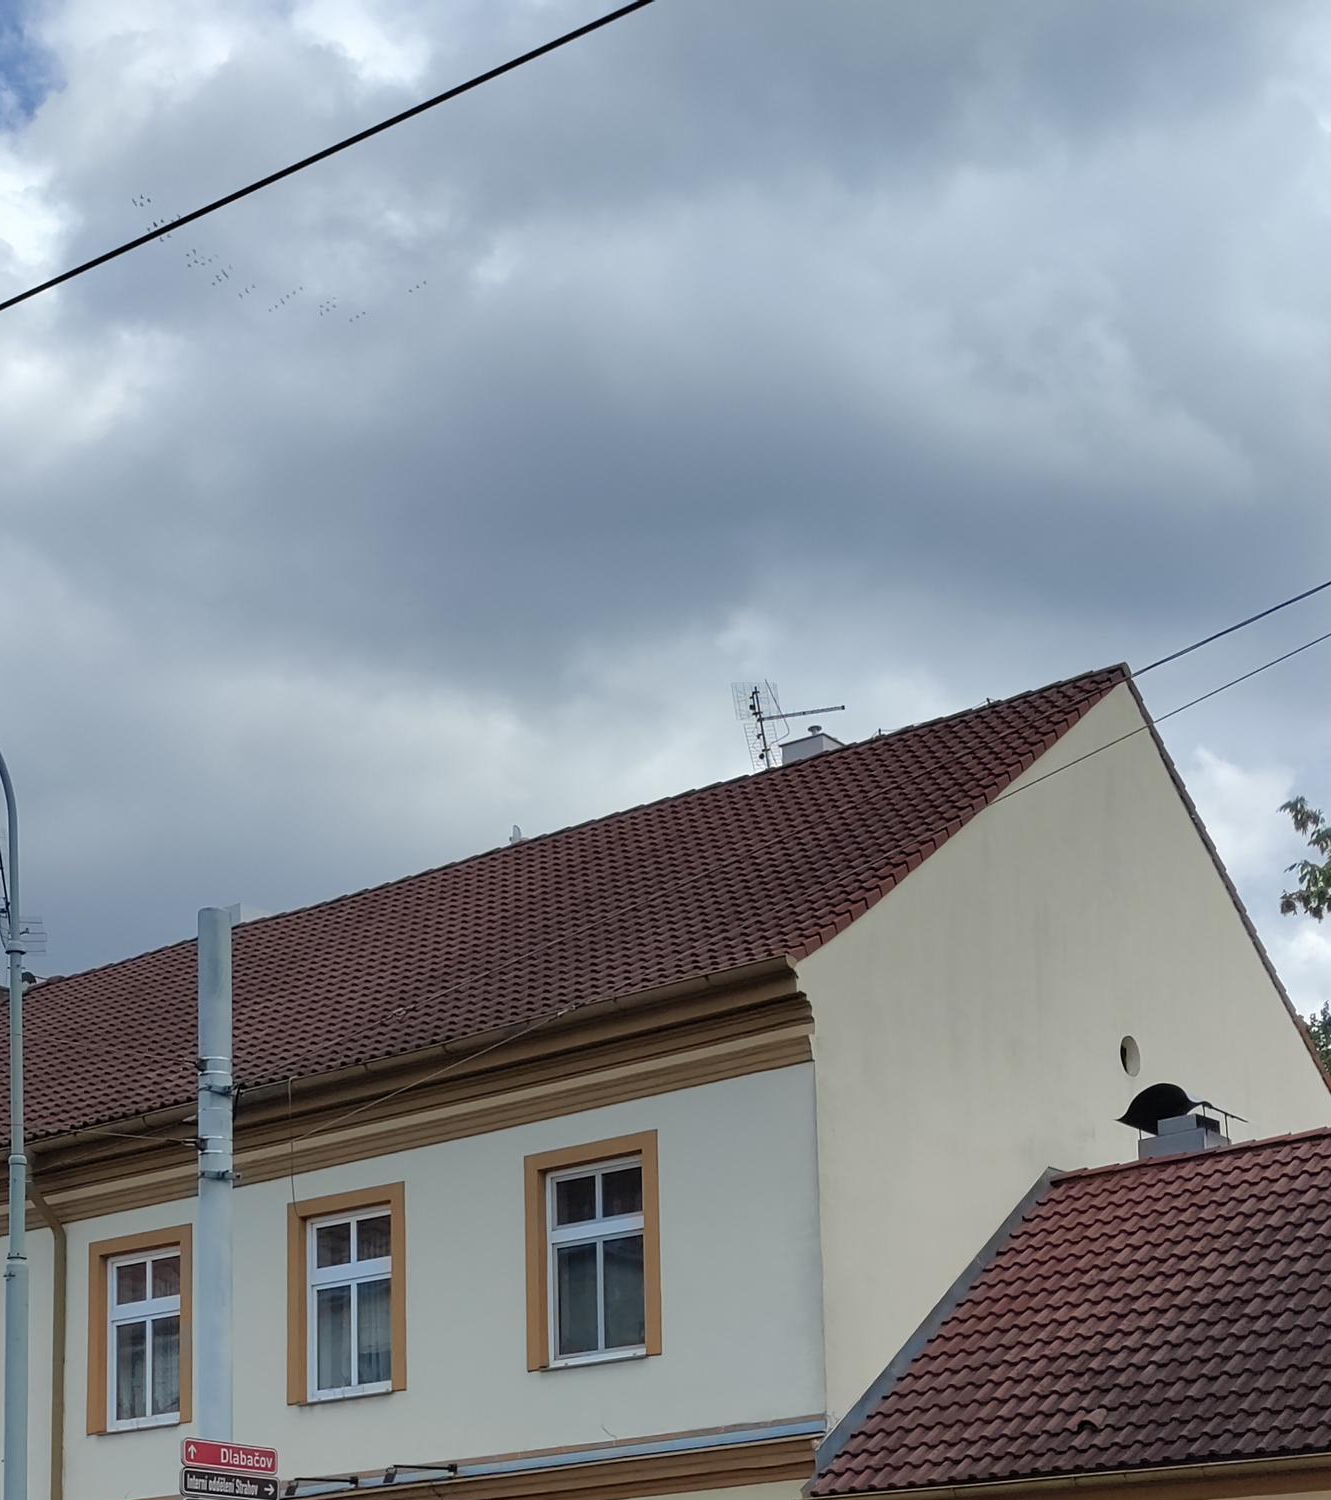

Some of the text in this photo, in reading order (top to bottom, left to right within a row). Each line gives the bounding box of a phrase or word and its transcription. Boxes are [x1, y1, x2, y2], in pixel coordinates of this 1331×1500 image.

[220, 1448, 273, 1468] Dlabačov
[187, 1473, 208, 1490] Interní
[235, 1479, 259, 1496] Strahov
